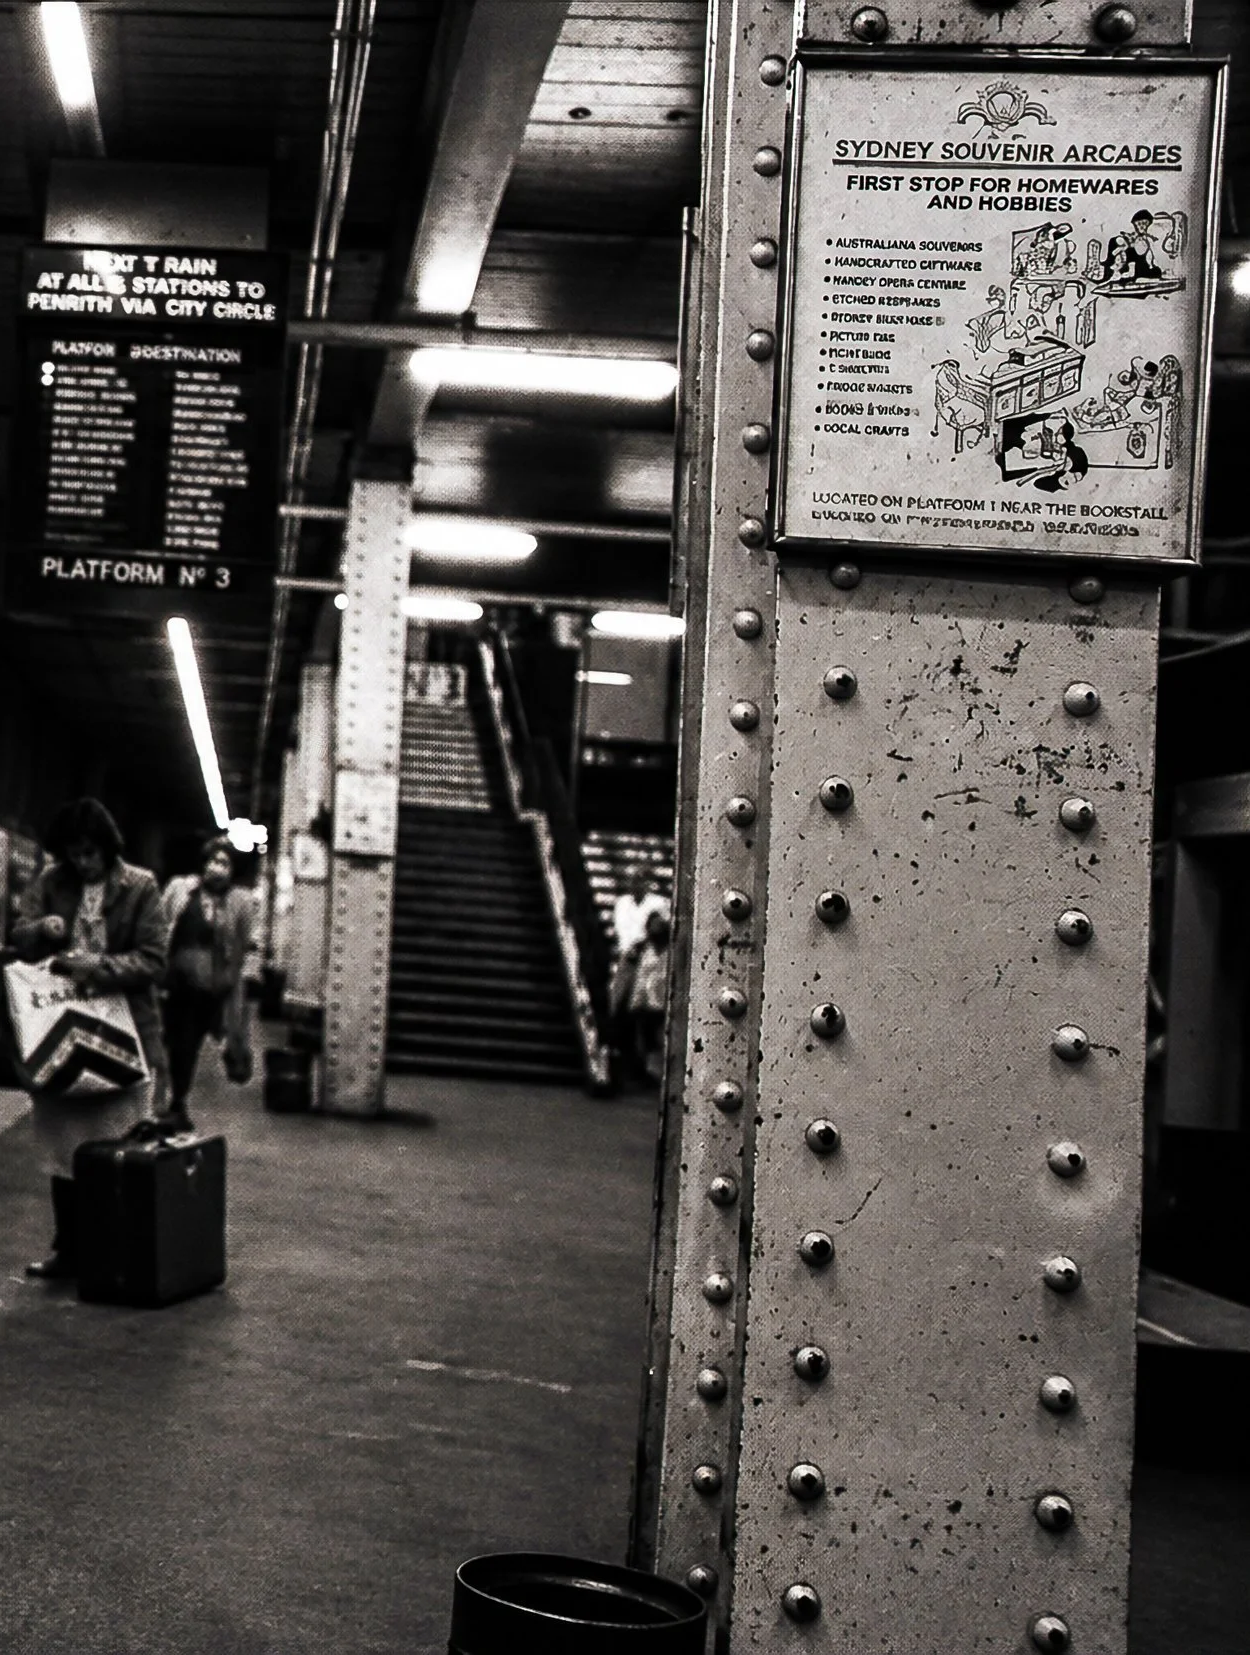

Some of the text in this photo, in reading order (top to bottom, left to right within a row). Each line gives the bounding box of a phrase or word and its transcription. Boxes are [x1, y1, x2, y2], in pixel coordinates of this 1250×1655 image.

[835, 139, 1182, 164] SYDNEY SOUVENIR ARCADES
[846, 175, 1159, 195] FIRST STOP FOR HOMEWARES
[926, 195, 1072, 213] AND HOBBIES
[36, 272, 65, 290] AT
[132, 276, 231, 298] STATIONS
[236, 281, 266, 299] TO
[27, 292, 277, 321] PENRITH VIA CITY CIRCLE
[1045, 503, 1076, 516] THE
[42, 556, 164, 584] PLATFORM
[214, 567, 231, 588] 3
